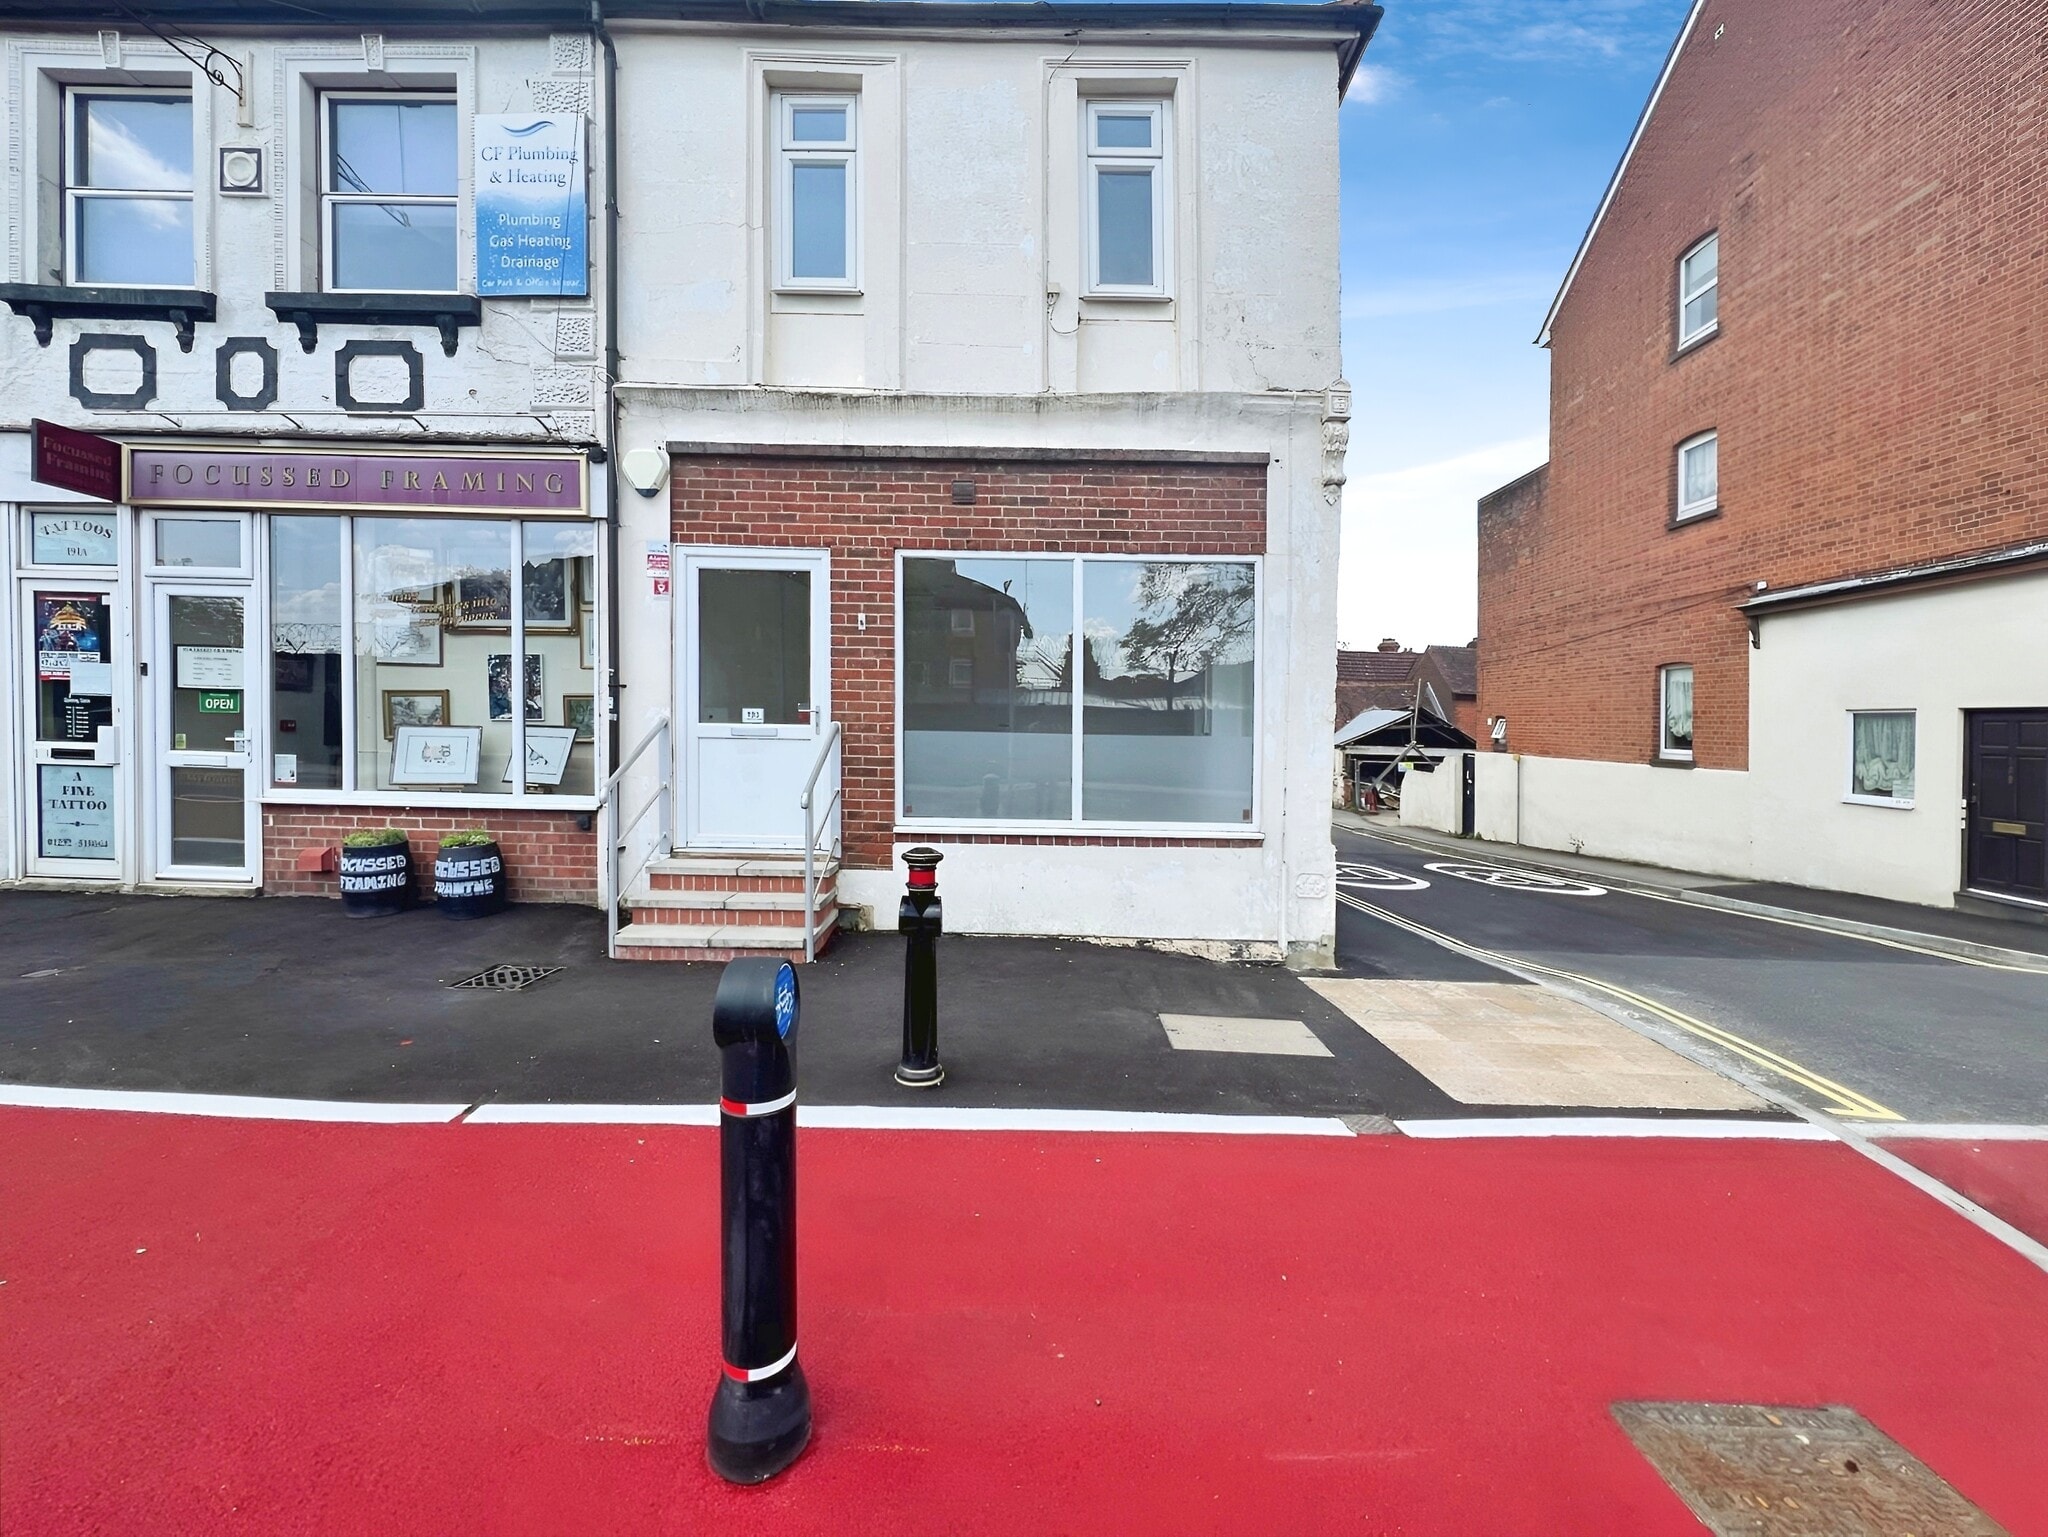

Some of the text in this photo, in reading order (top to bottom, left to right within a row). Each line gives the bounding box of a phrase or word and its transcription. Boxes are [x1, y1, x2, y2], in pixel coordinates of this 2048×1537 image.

[481, 146, 578, 164] CF Plumbing
[489, 168, 566, 187] & Heating
[499, 213, 561, 229] Plumbing
[489, 234, 571, 250] Gas Heating
[501, 254, 559, 270] Drainage
[43, 436, 112, 466] Focussed
[46, 452, 112, 483] Framing
[149, 464, 564, 494] FOCUSSED FRAMING
[40, 520, 113, 539] TATTOOS
[67, 547, 88, 556] 191A
[473, 596, 498, 609] into
[205, 698, 234, 709] OPEN
[73, 772, 82, 782] A
[62, 785, 95, 796] FINE
[48, 799, 107, 810] TATTOO
[341, 855, 406, 872] OCUSSED
[435, 856, 500, 878] OCUSSED
[340, 872, 407, 890] FRAMING
